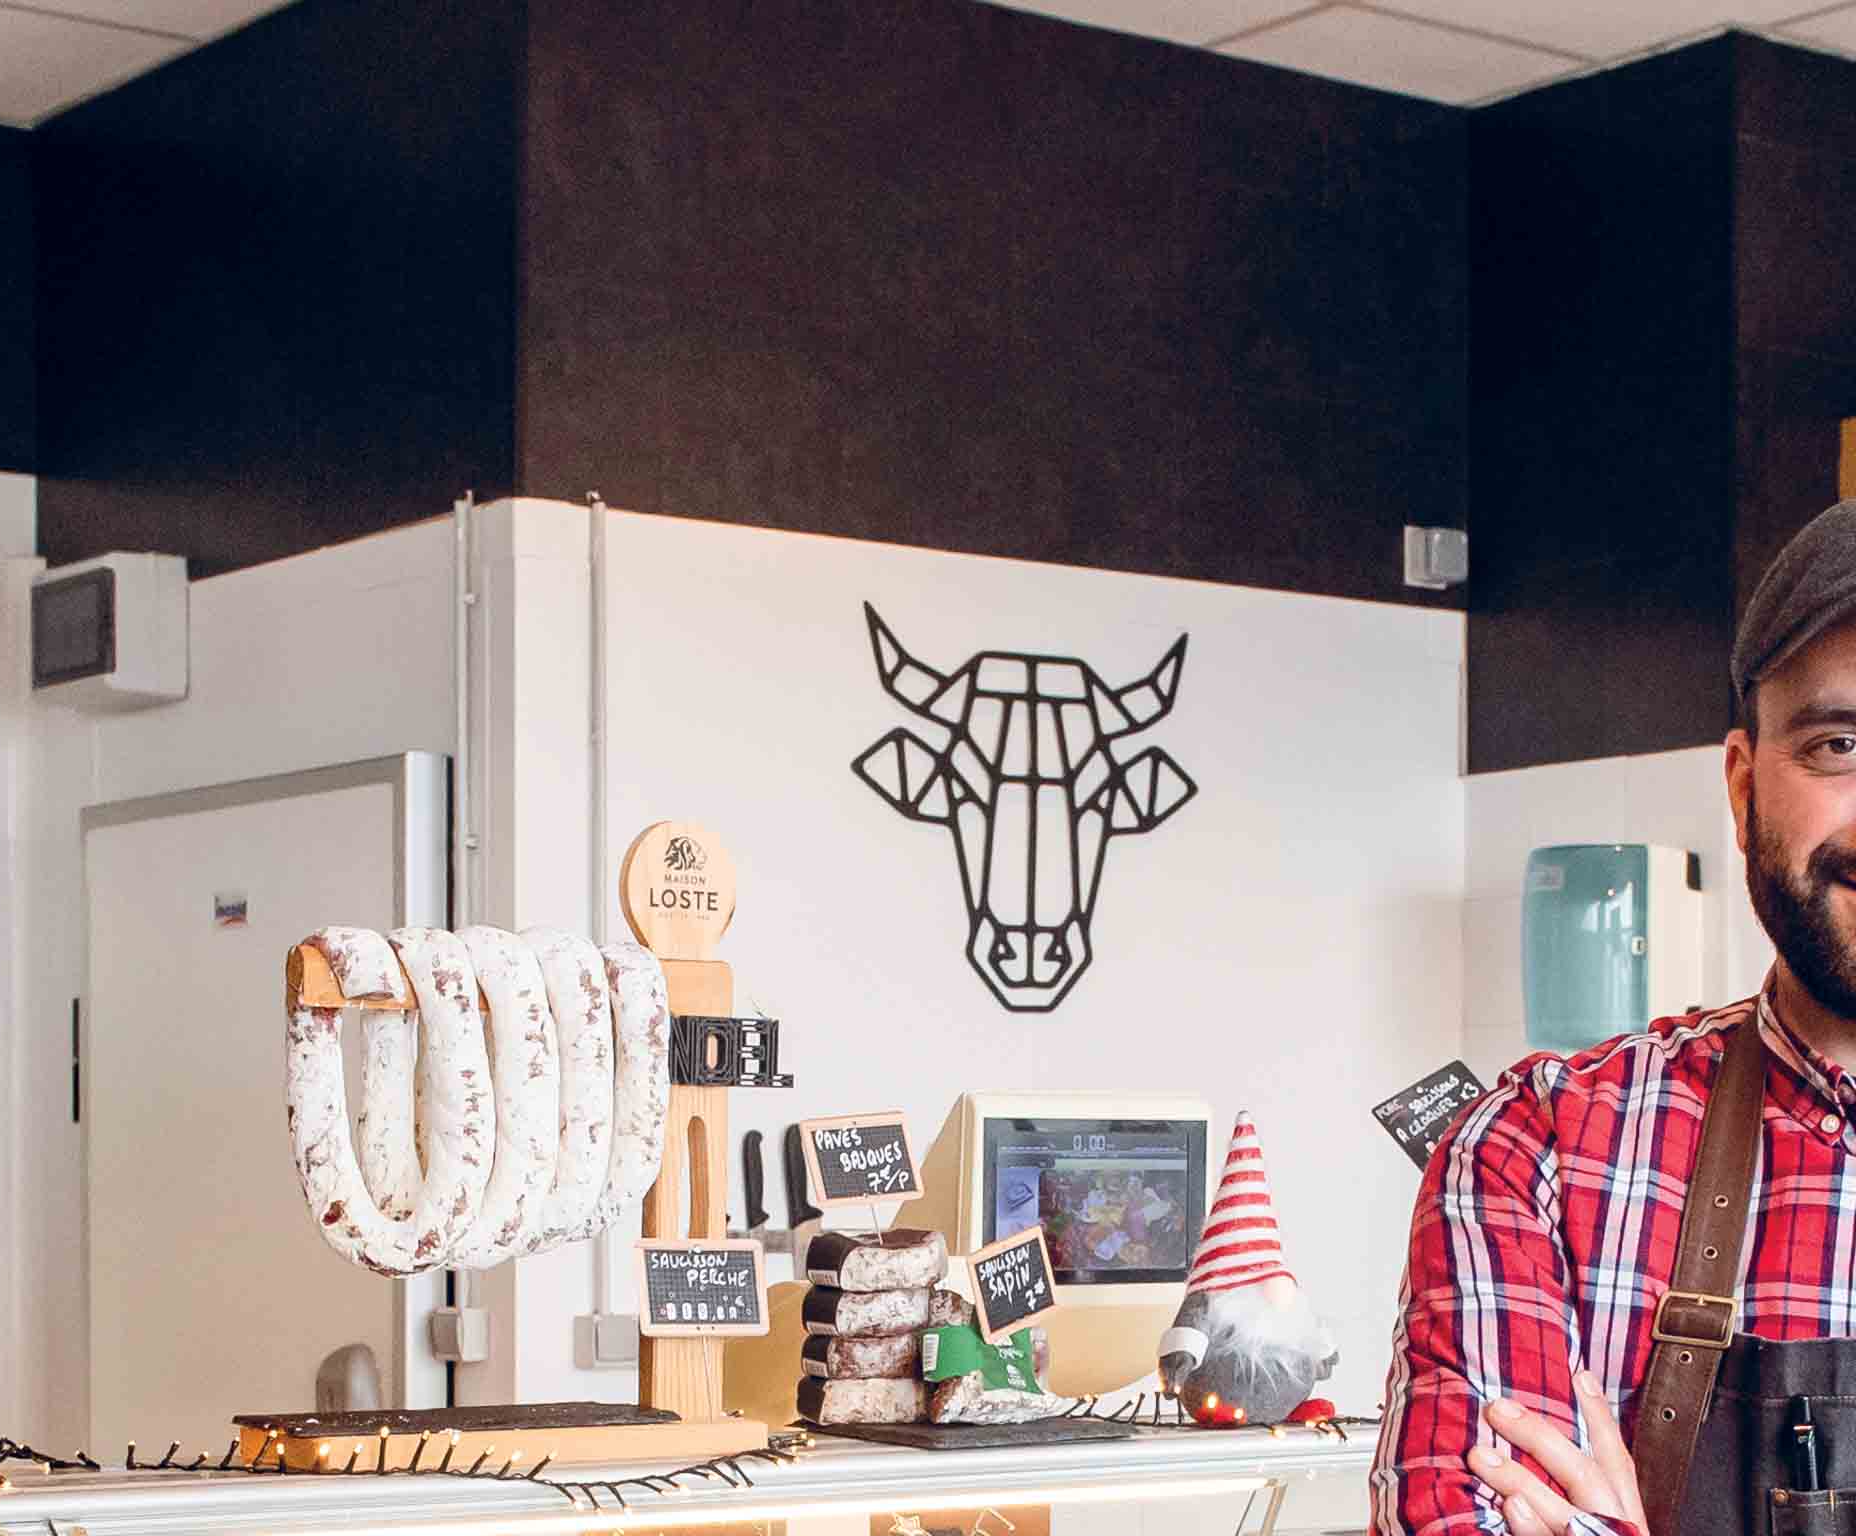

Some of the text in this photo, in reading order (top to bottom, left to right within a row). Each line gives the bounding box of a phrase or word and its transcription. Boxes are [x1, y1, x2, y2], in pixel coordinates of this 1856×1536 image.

[664, 874, 706, 885] MAISON
[650, 888, 719, 911] LOSTE
[686, 1269, 748, 1288] PERCHE
